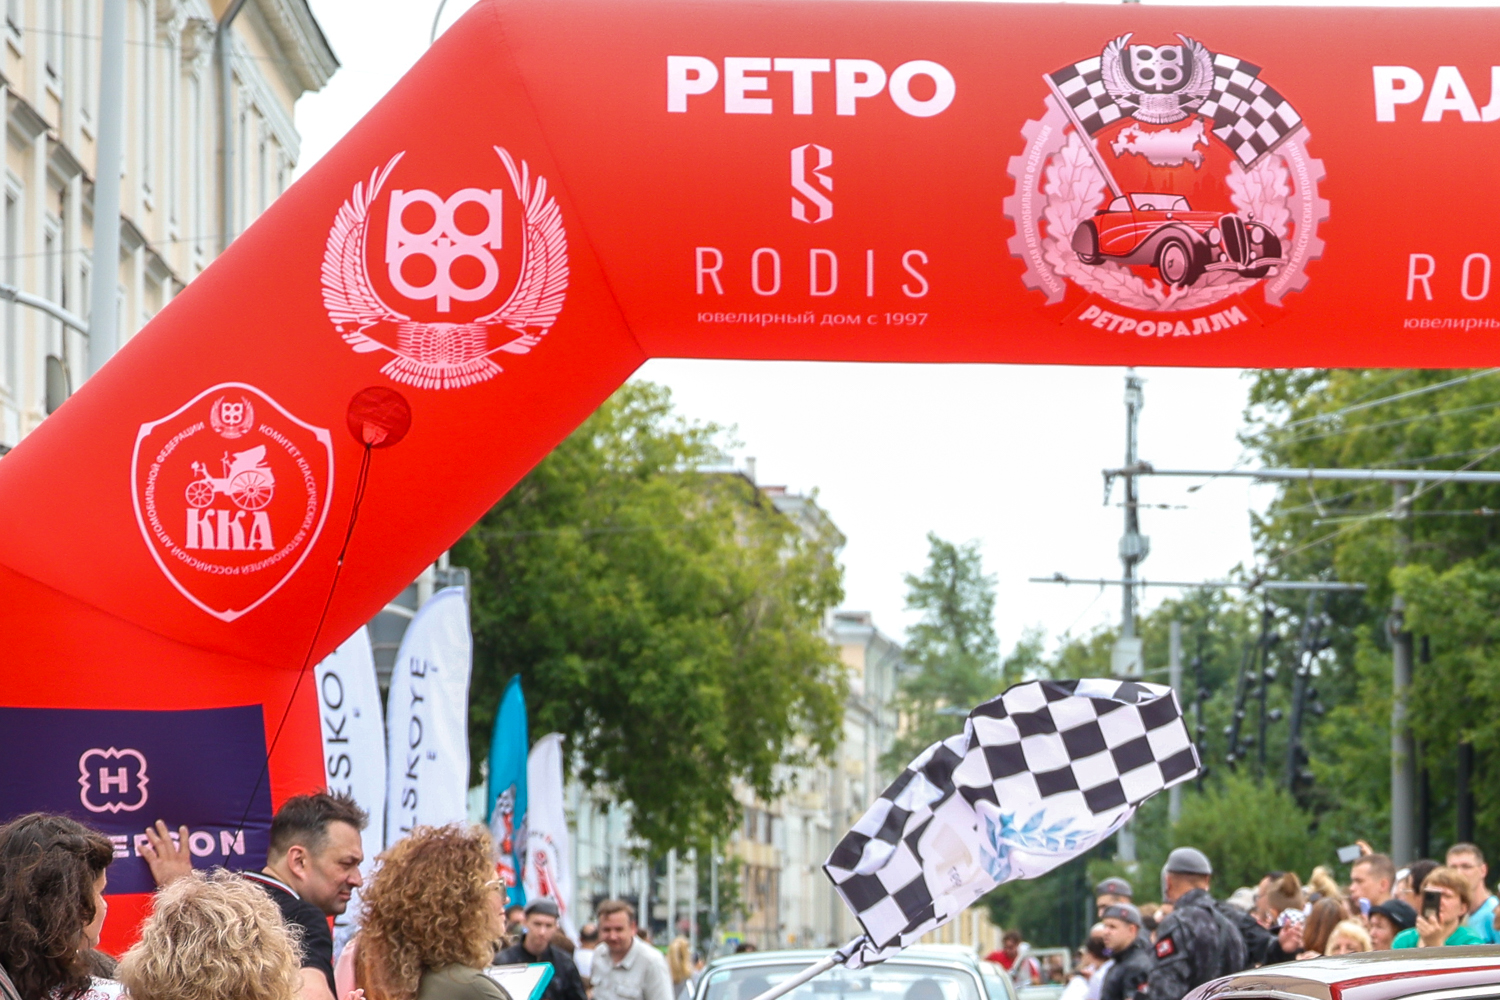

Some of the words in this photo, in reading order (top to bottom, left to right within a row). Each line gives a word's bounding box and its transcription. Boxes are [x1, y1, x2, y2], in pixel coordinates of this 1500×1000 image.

[666, 55, 957, 118] РЕТРО
[1028, 124, 1052, 175] ФЕДЕРАЦИЯ
[1286, 140, 1312, 202] АВТОМОБИЛЕЙ
[1021, 175, 1037, 249] АВТОМОБИЛЬНАЯ
[1295, 202, 1312, 264] КЛАССИЧЕСКИХ
[695, 246, 930, 299] RODIS
[1030, 248, 1061, 293] РОССИЙСКАЯ
[1270, 261, 1298, 293] КОМИТЕТ
[697, 311, 815, 327] ювелирный
[820, 313, 860, 326] дом
[867, 315, 878, 325] с
[885, 312, 929, 326] 1997
[1077, 304, 1248, 337] РЕТРОРАЛЛИ
[157, 421, 205, 463] ФЕДЕРАЦИИ
[258, 423, 301, 458] КОМИТЕТ
[144, 464, 174, 547] АВТОМОБИЛЬНОЙ
[297, 457, 318, 530] КЛАССИЧЕСКИХ
[185, 508, 275, 550] ККА
[171, 545, 240, 576] РОССИЙСКОЙ
[241, 529, 308, 575] АВТОМОБИЛЕЙ
[99, 767, 128, 794] H
